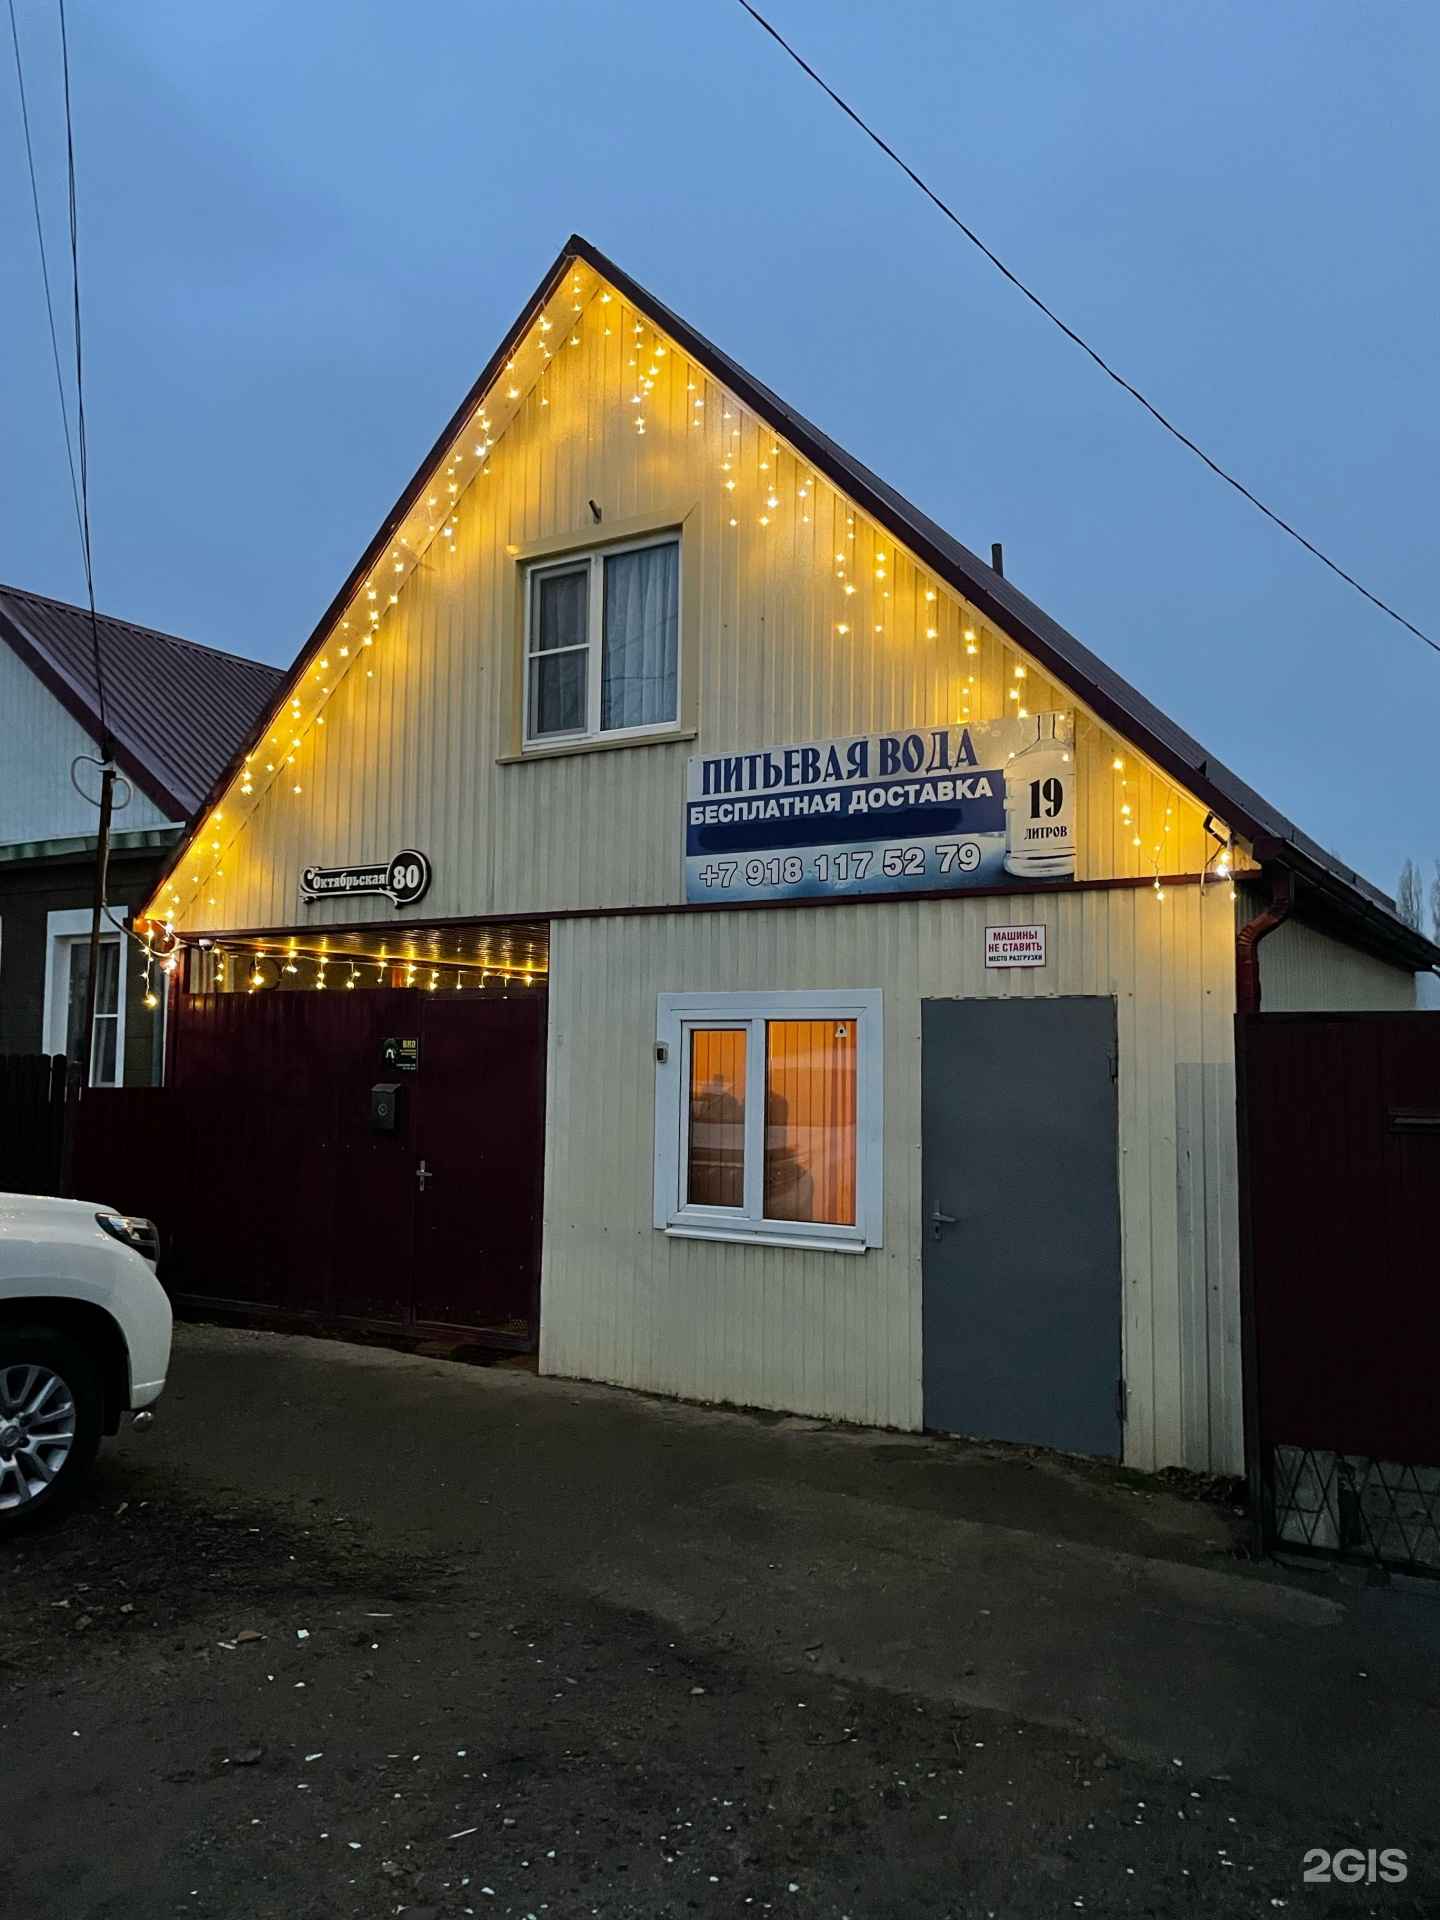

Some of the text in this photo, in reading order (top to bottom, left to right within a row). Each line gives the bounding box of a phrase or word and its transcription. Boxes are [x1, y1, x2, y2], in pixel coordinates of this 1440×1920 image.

[702, 728, 979, 795] ПИТЬЕВАЯ ВОДА
[690, 777, 993, 825] БЕСПЛАТНАЯ ДОСТАВКА
[1028, 778, 1063, 819] 19
[1024, 826, 1068, 840] ЛИТРОВ
[393, 865, 420, 889] 80
[700, 843, 981, 888] +7 918 117 52 79
[313, 872, 386, 890] Октябрьская
[988, 942, 1042, 952] НЕ СТАВИТЬ
[993, 930, 1038, 941] МАШИНЫ
